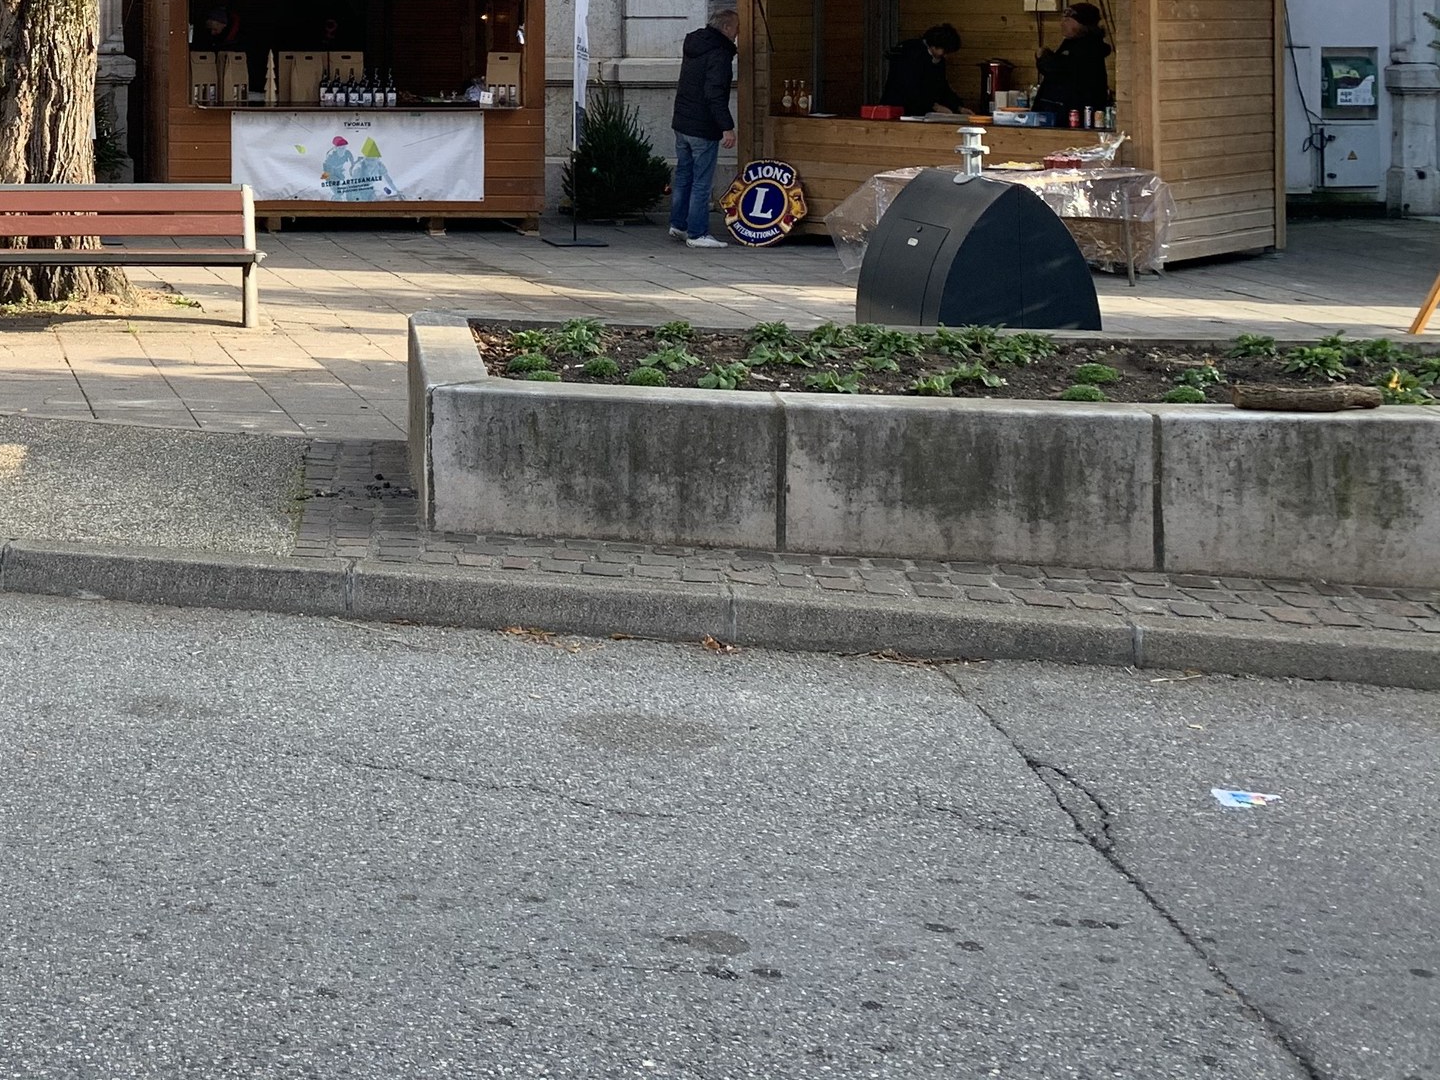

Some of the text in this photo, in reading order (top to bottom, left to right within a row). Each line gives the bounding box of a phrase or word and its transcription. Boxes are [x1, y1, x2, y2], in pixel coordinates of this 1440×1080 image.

[342, 176, 382, 185] ARTISANALE
[748, 165, 792, 185] LIONS
[749, 187, 773, 219] L
[732, 221, 781, 239] INTERNATIONAL
